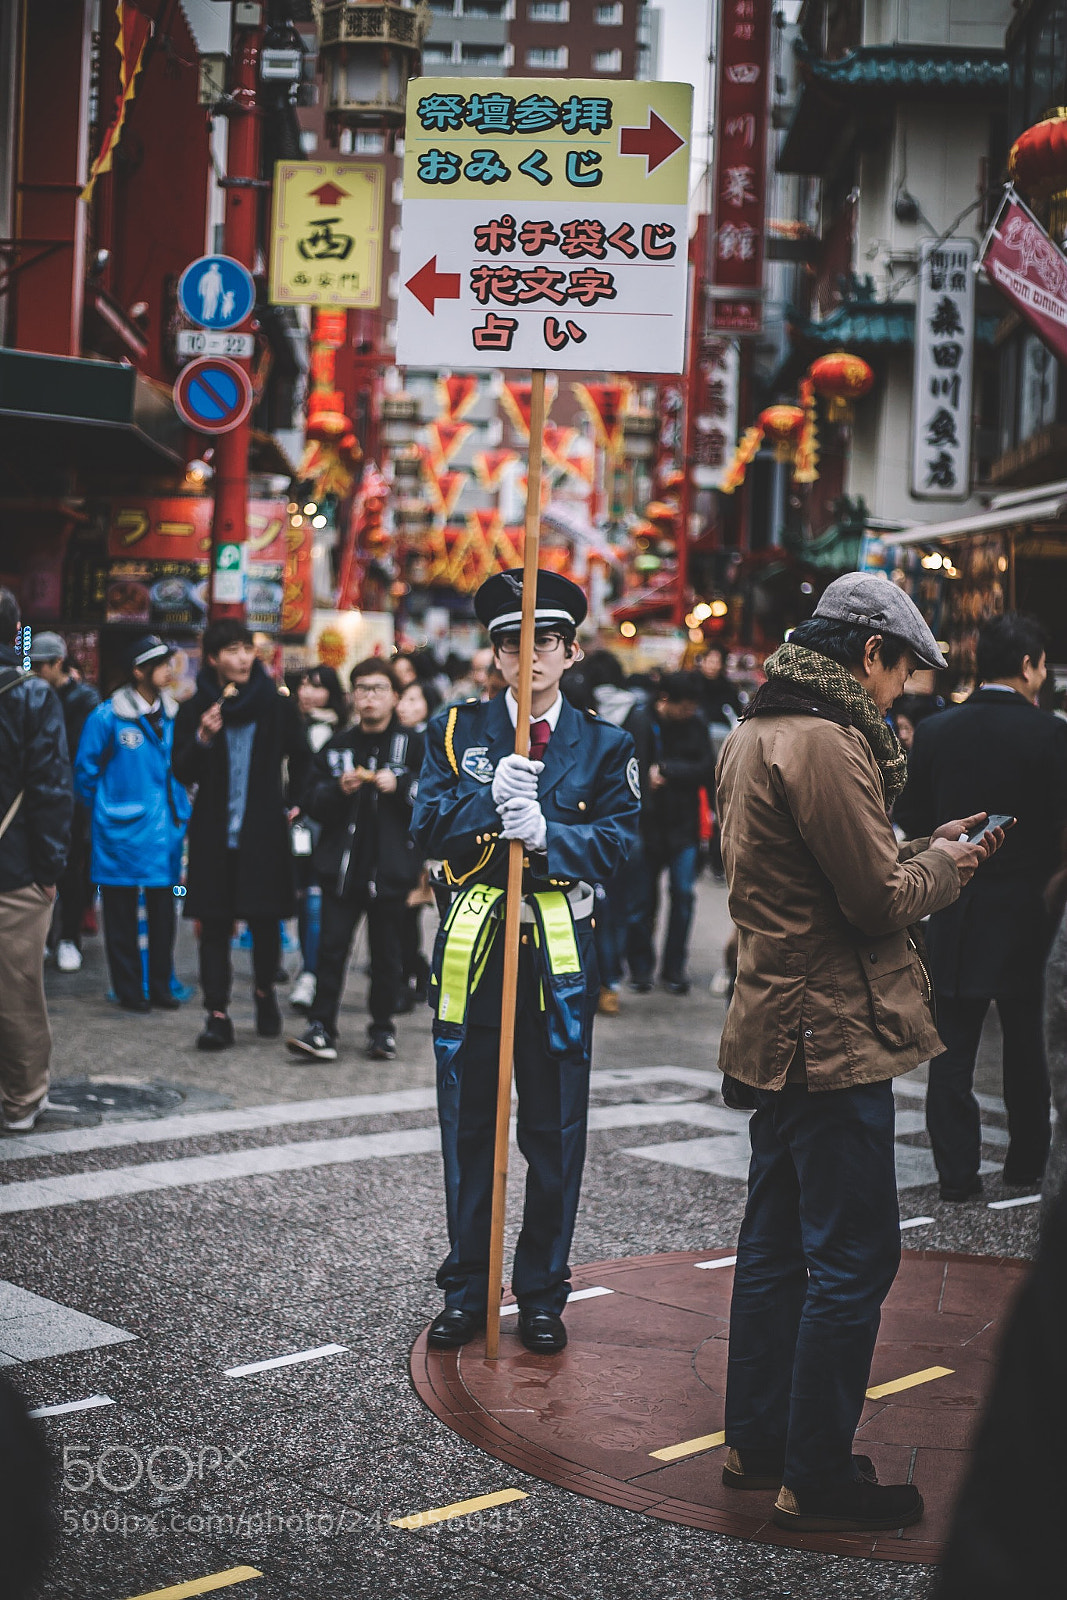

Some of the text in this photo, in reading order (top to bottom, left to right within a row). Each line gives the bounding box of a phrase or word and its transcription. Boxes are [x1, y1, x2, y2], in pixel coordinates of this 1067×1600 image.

[417, 93, 613, 135] 祭壇参拝
[417, 149, 603, 187] おみくじ
[296, 217, 356, 260] 西
[474, 214, 676, 259] ポチ袋くじ
[470, 265, 617, 306] 花文字
[472, 312, 587, 351] 占い
[117, 508, 283, 552] ラーン
